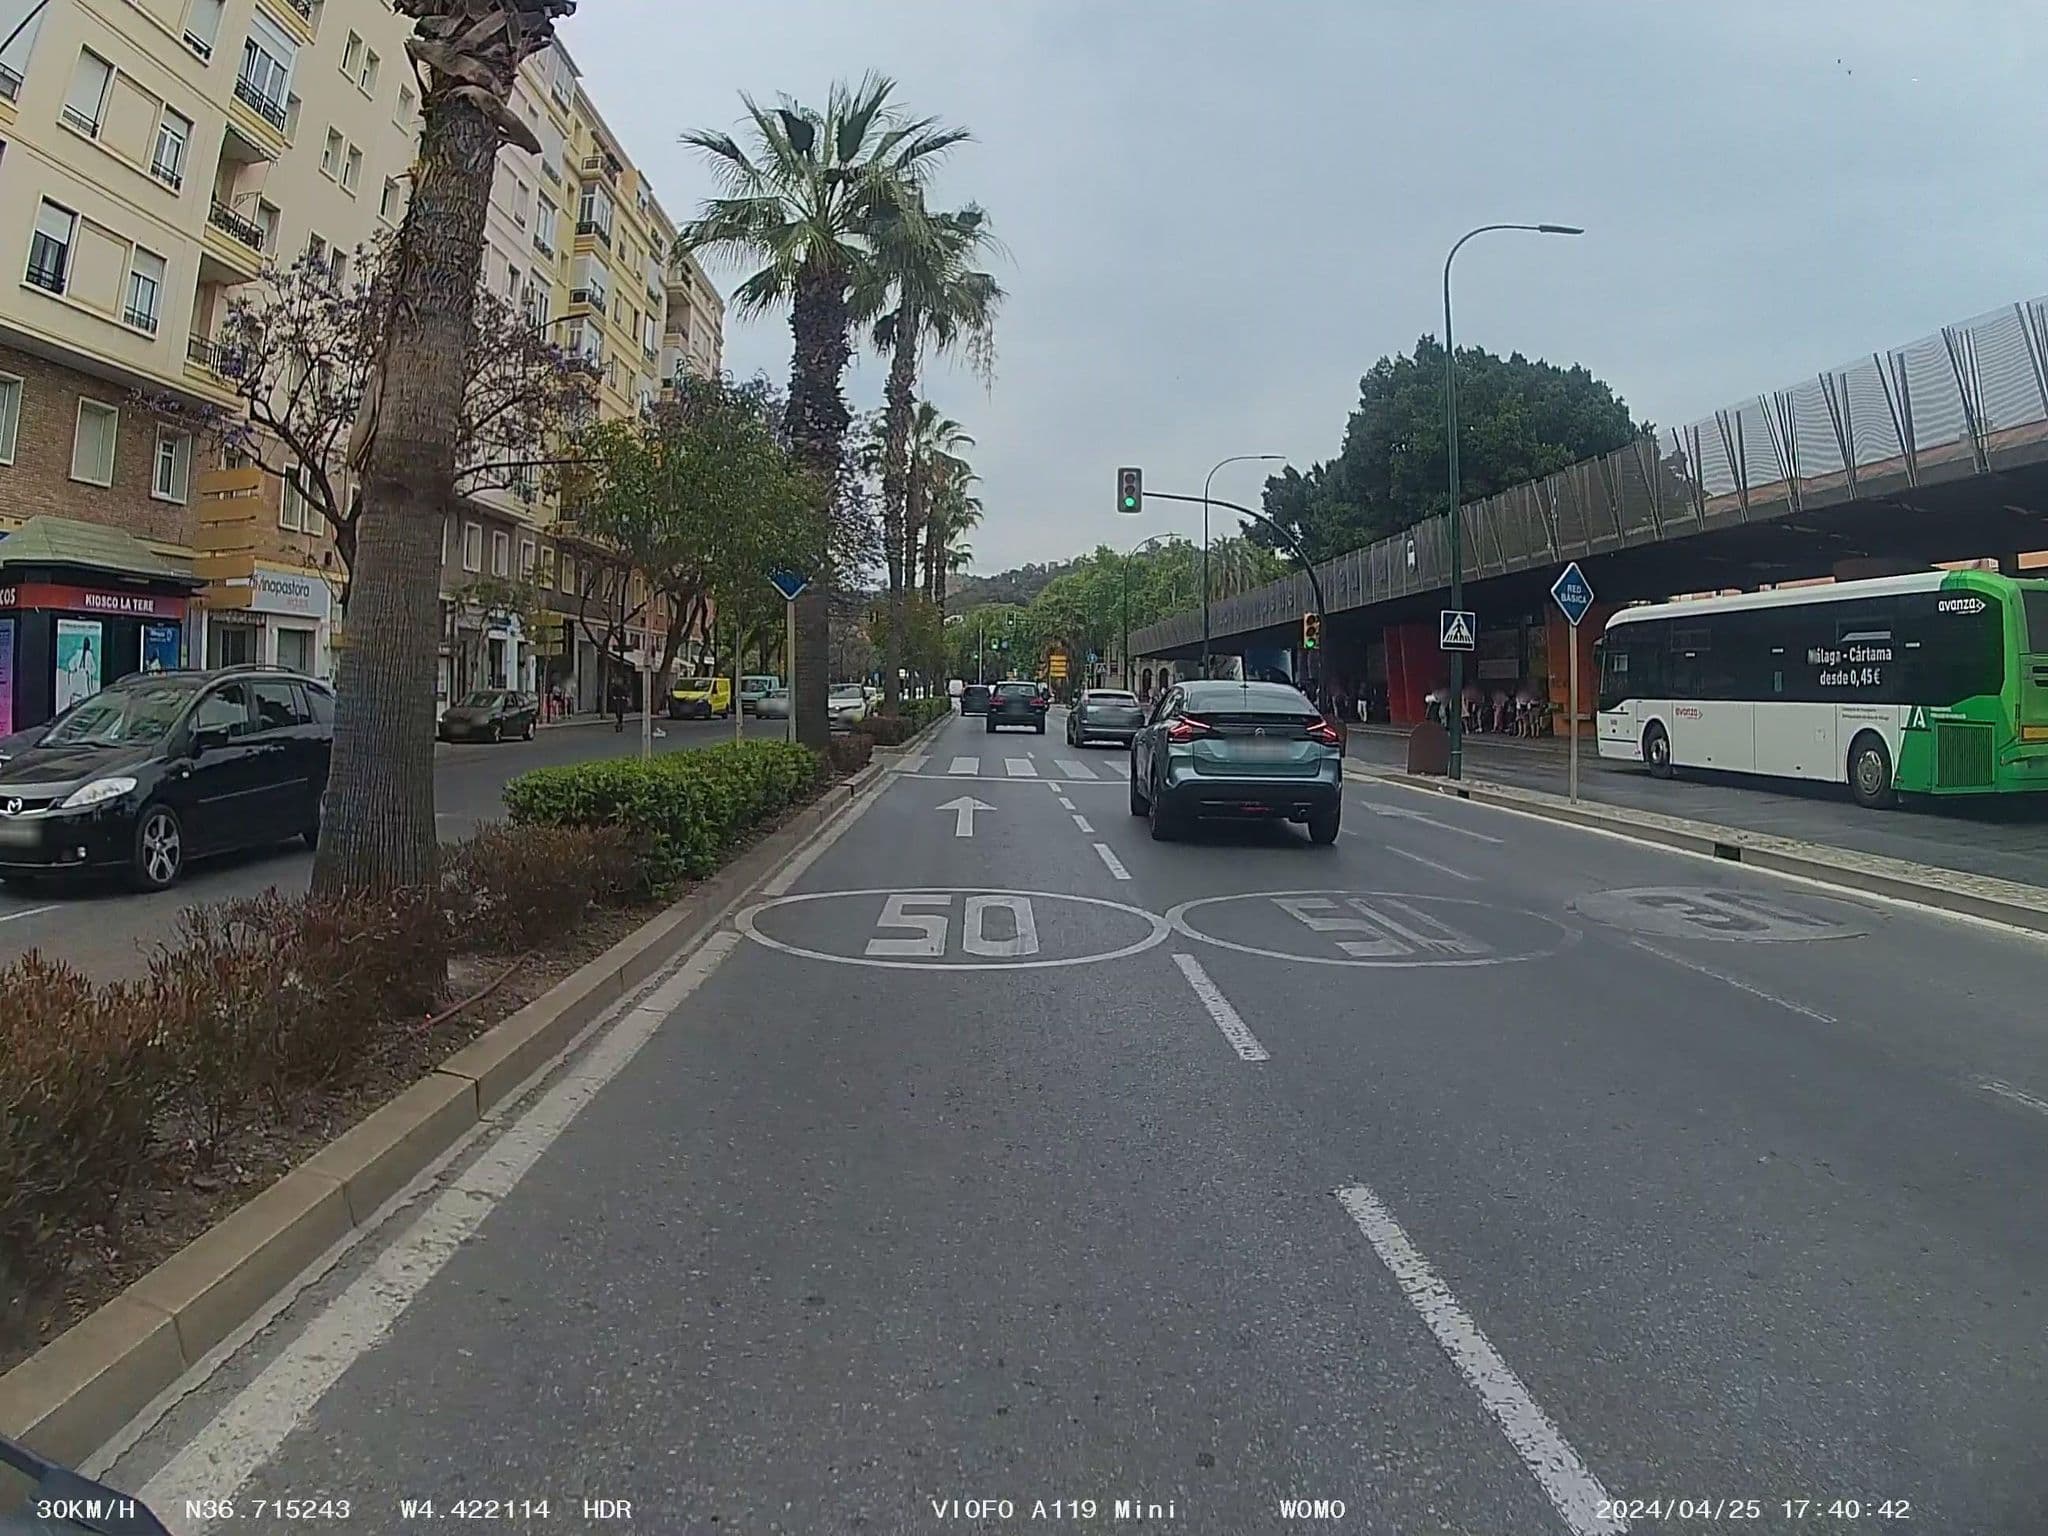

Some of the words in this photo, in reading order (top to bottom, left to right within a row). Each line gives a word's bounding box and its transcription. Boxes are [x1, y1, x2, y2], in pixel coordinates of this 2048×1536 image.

[1567, 584, 1582, 594] RED
[85, 593, 118, 609] KIOSCO
[120, 597, 131, 611] LA
[1938, 598, 1976, 612] avanza
[1849, 644, 1892, 662] Cártama
[1820, 671, 1849, 685] desde
[864, 894, 1040, 957] 50
